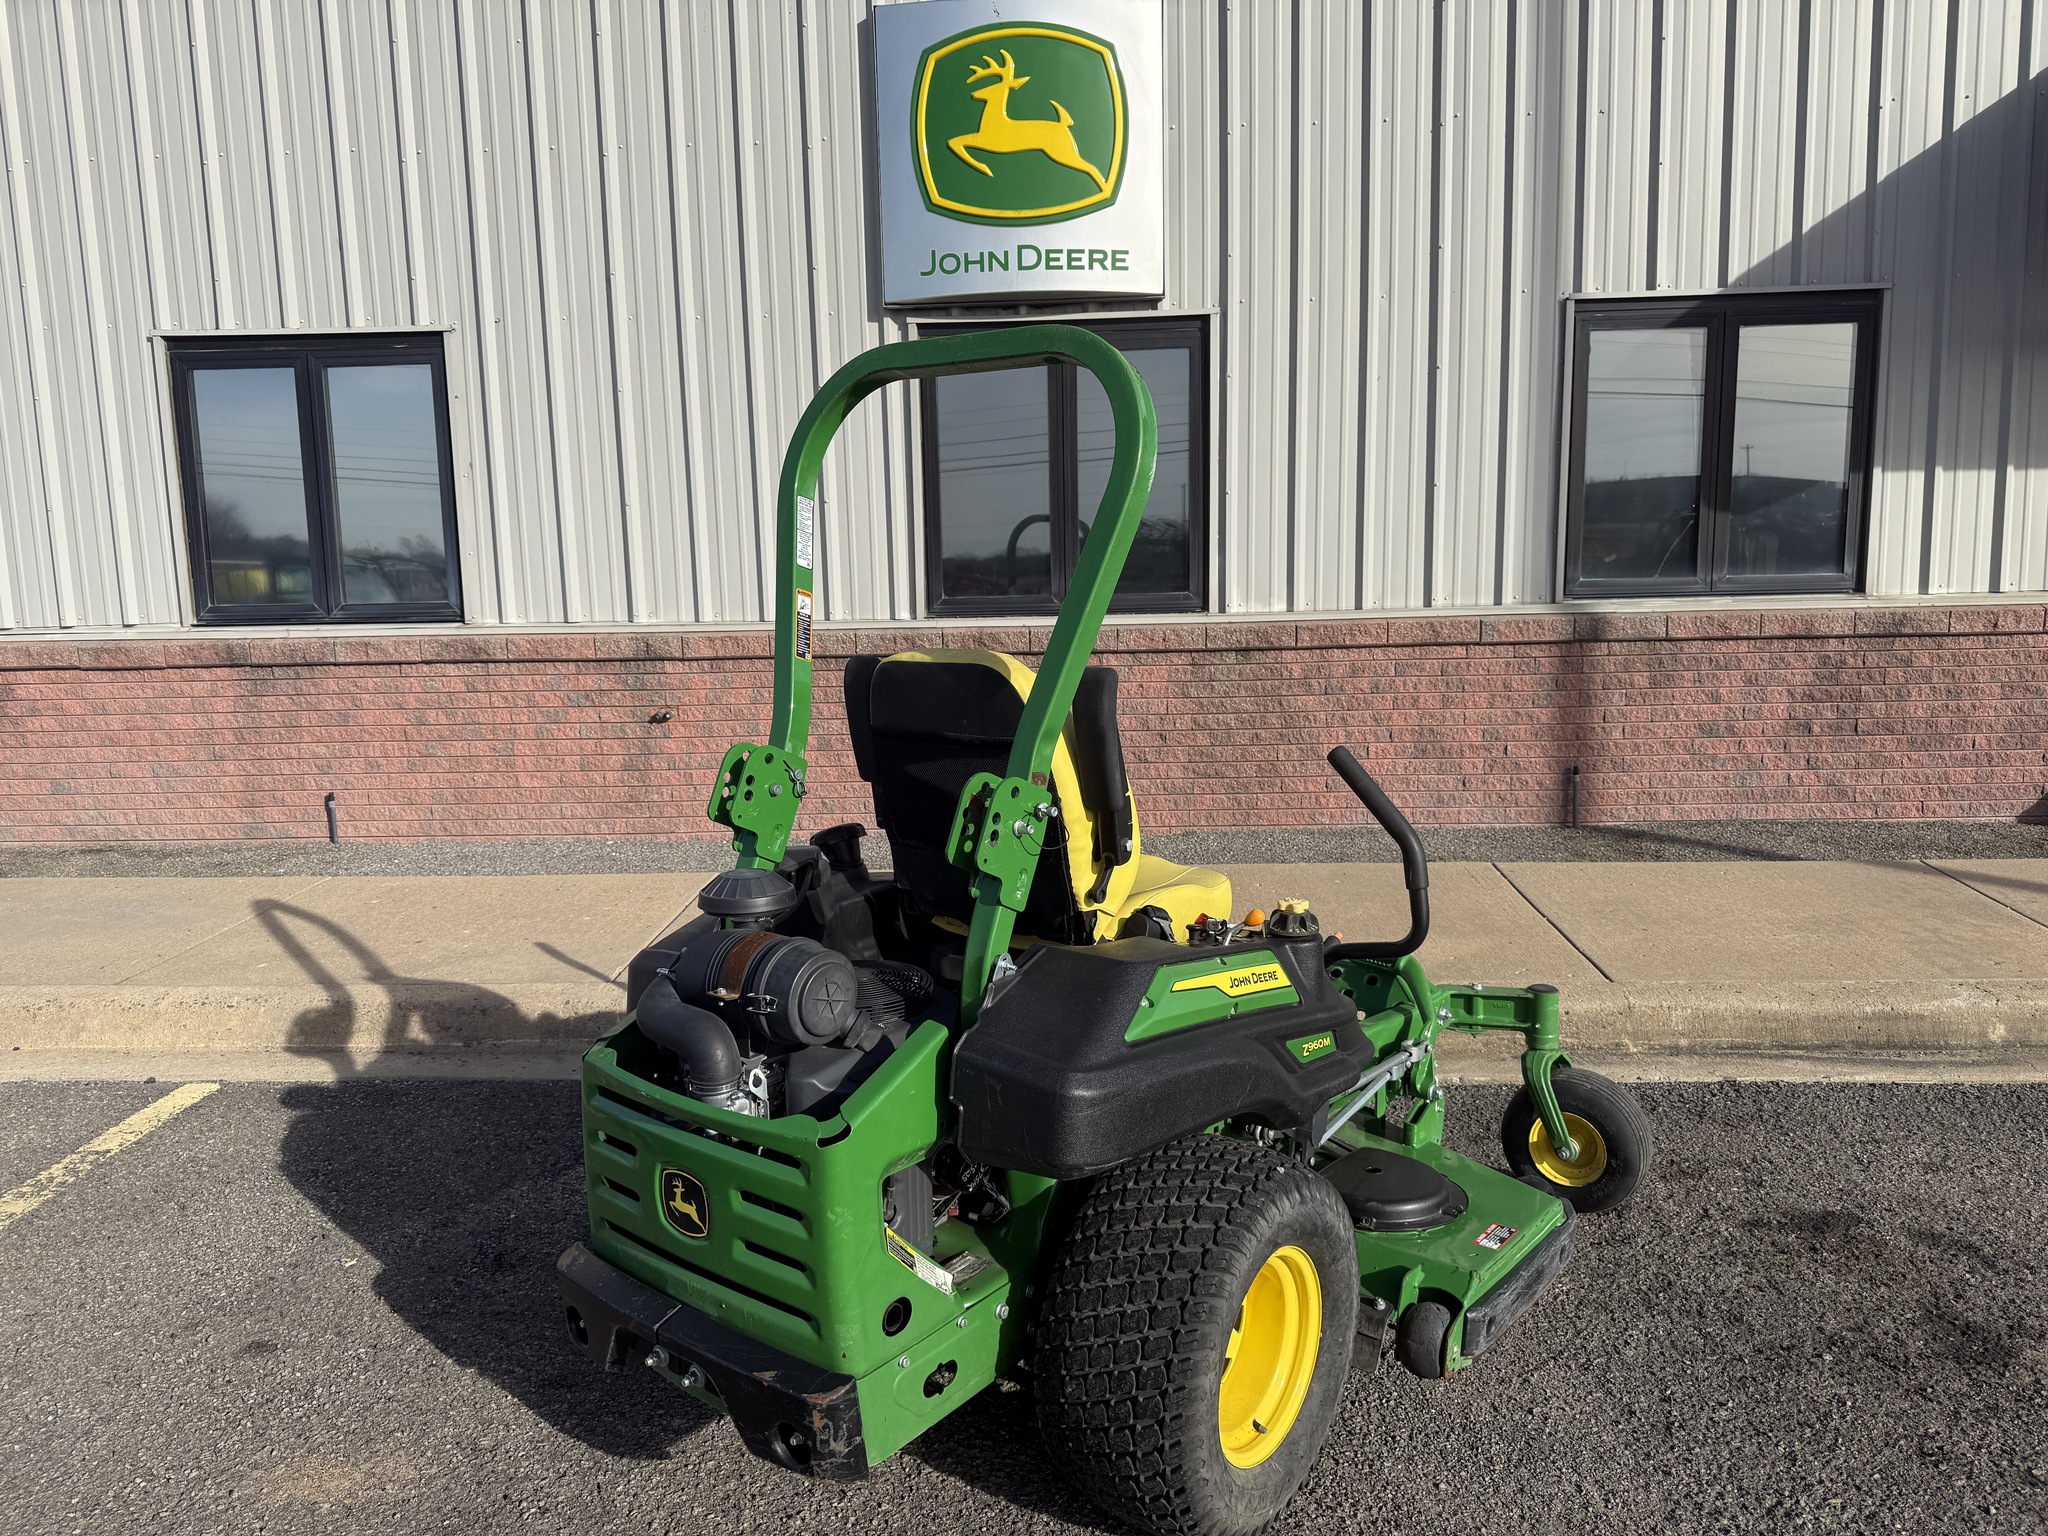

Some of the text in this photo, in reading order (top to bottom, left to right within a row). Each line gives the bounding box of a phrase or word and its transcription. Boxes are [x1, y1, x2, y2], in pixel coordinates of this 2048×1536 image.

[920, 244, 1130, 276] JOHN DEERE
[1229, 970, 1279, 989] JOHN DEERE
[1302, 1036, 1331, 1057] Z960M
